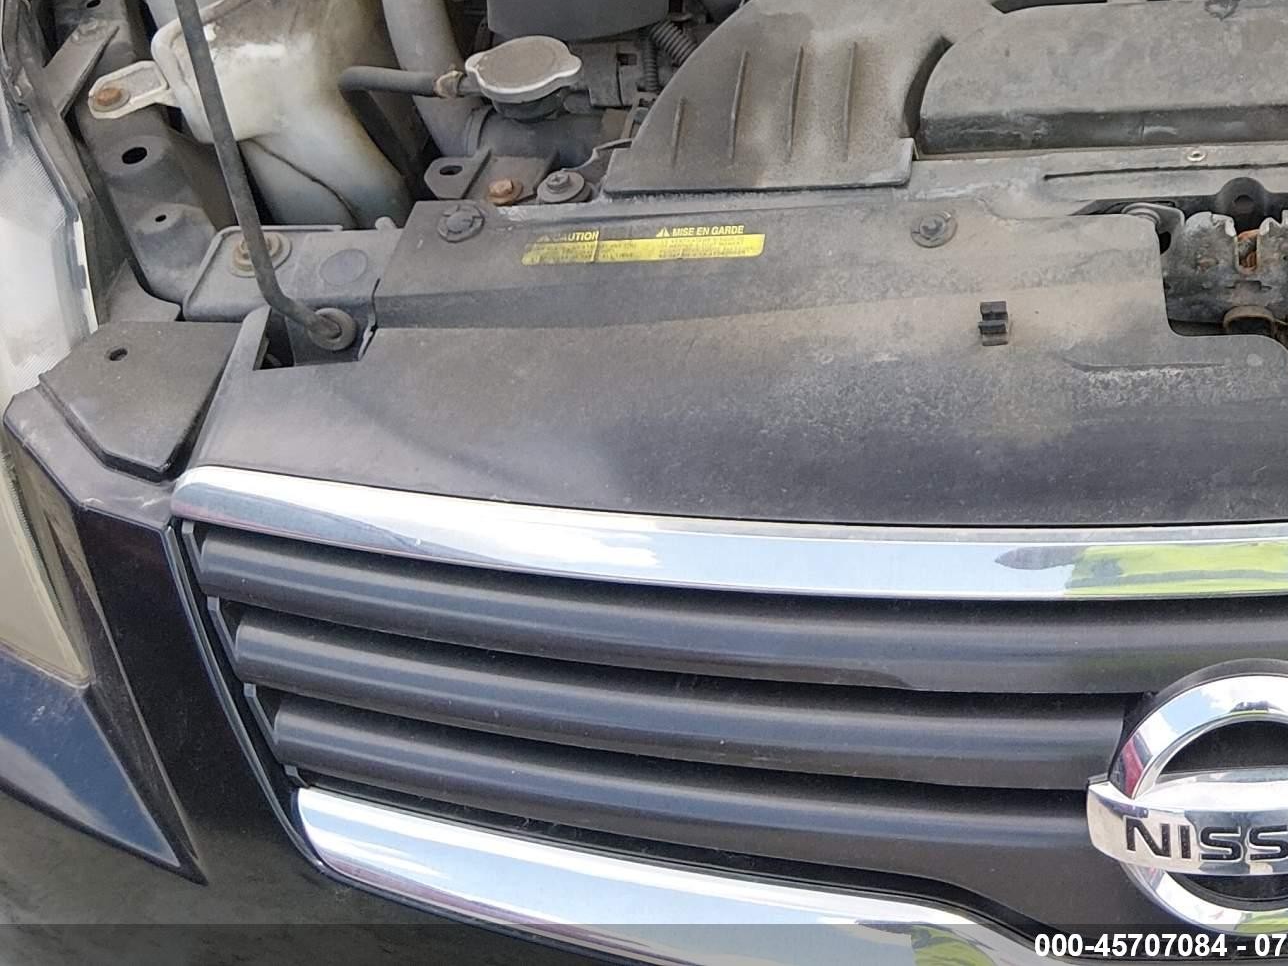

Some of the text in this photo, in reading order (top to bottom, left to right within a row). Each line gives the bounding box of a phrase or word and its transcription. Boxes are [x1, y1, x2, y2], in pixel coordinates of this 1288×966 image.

[672, 225, 745, 237] MISE EN GARDE
